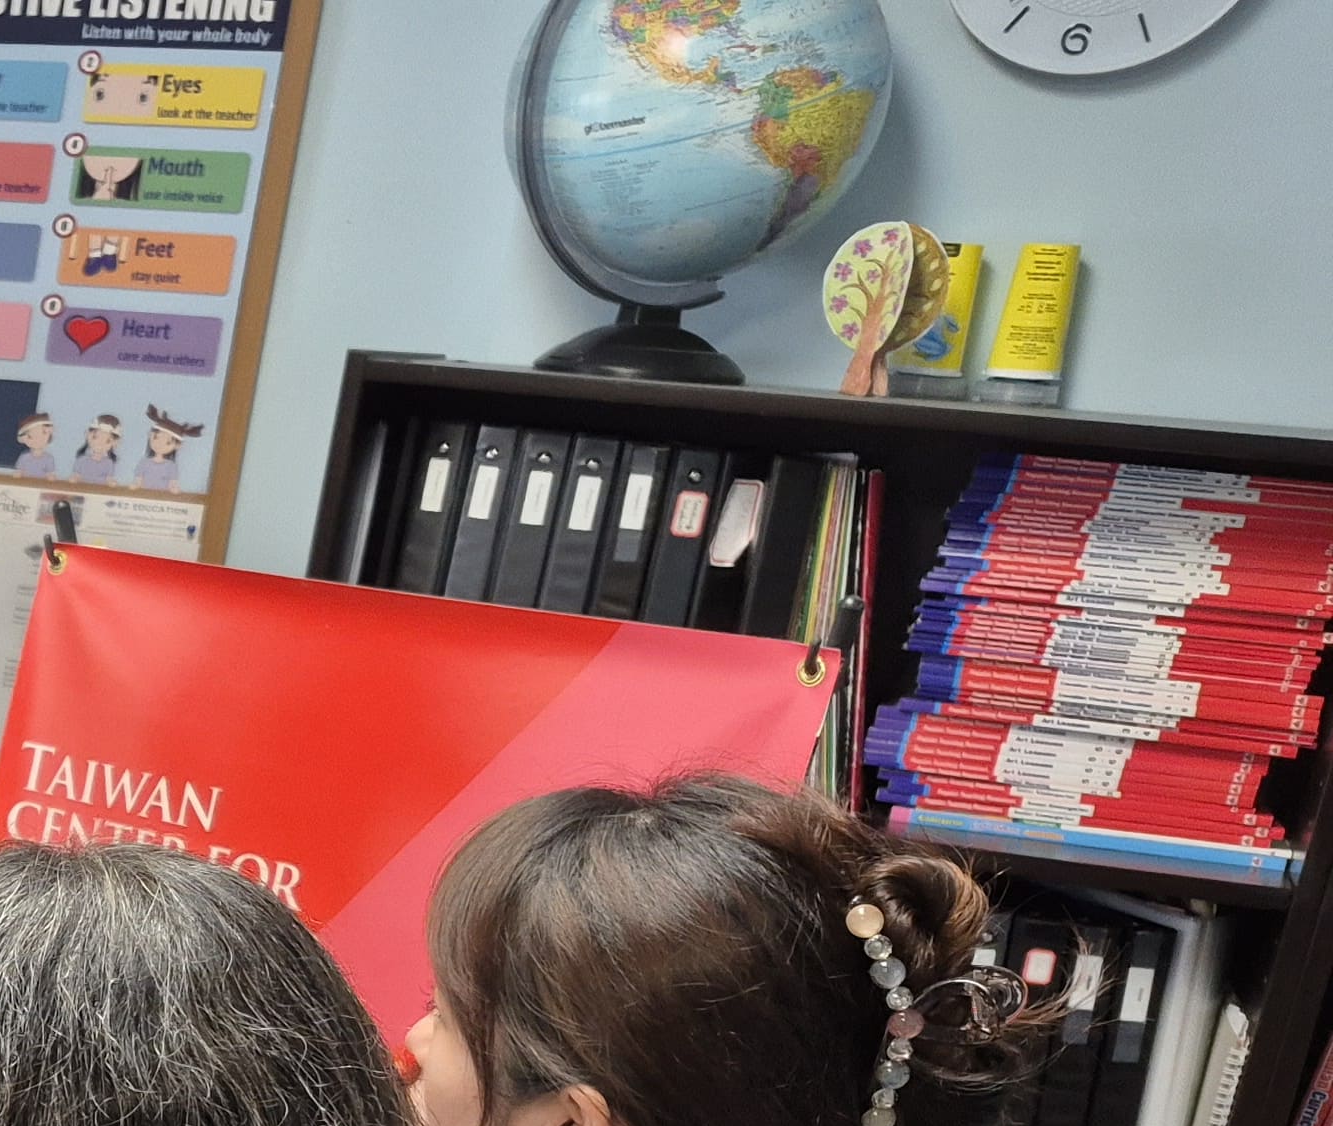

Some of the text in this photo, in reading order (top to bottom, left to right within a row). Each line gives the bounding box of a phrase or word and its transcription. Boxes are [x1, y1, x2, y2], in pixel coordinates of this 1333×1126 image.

[88, 0, 277, 22] LISTENING
[83, 23, 272, 45] Listen with your whole body
[1061, 23, 1092, 55] 6
[161, 74, 201, 96] Eyes
[157, 107, 256, 122] look at the teacher
[147, 156, 205, 179] Mouth
[135, 237, 175, 259] Feet
[155, 271, 181, 286] quiet
[122, 318, 172, 341] Heart
[21, 740, 223, 833] TAIWAN
